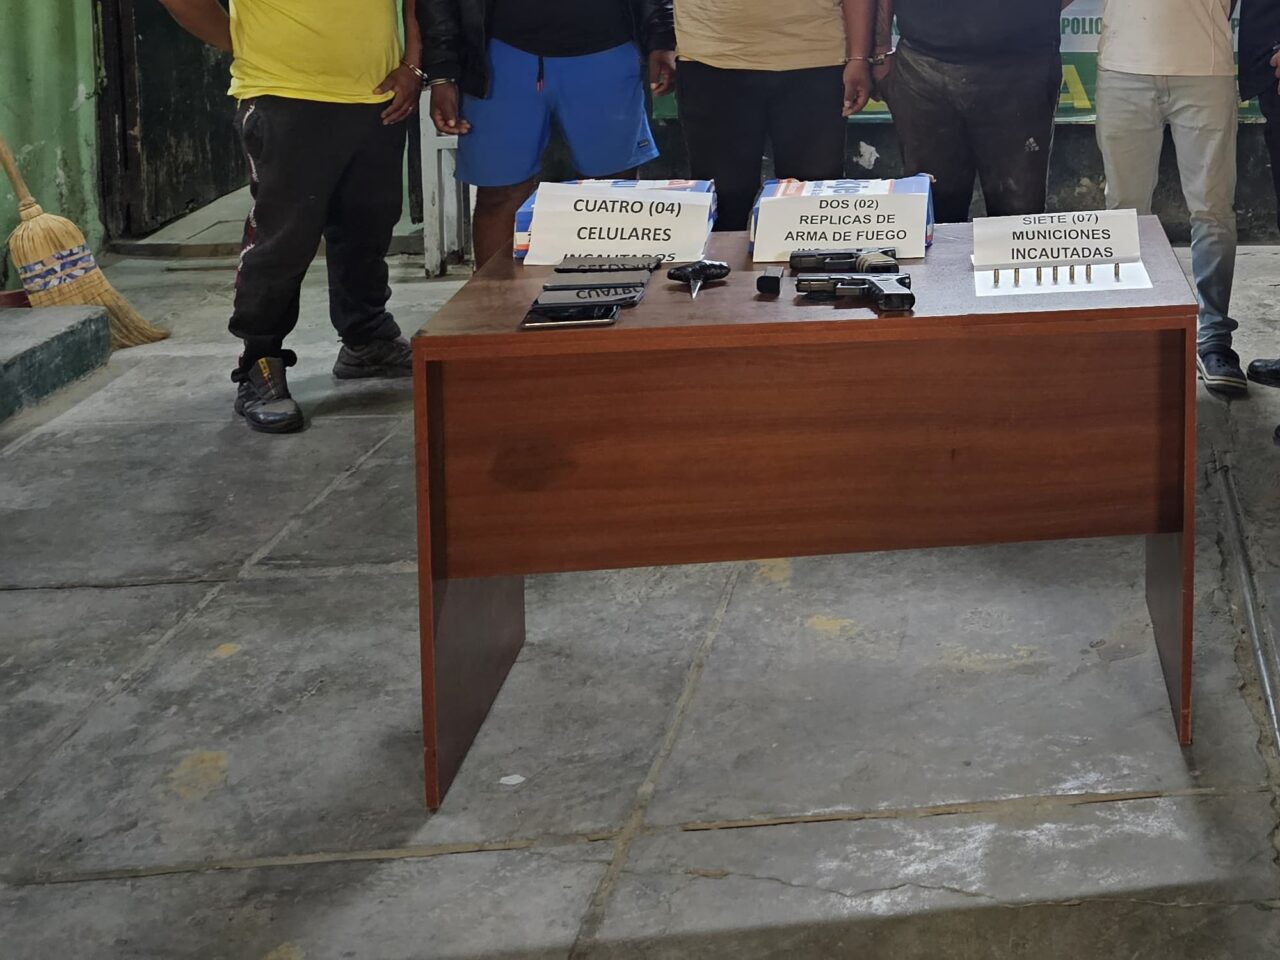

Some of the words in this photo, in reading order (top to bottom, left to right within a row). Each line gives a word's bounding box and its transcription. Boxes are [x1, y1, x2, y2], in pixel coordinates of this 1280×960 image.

[573, 199, 643, 214] CUATRO
[648, 201, 682, 217] (04)
[818, 199, 850, 209] DOS
[853, 199, 879, 211] (02)
[799, 214, 872, 225] REPLICAS
[876, 214, 896, 224] DE
[1022, 215, 1067, 225] SIETE
[1071, 213, 1099, 225] (07)
[576, 226, 672, 242] CELULARES
[784, 231, 829, 241] ARMA
[832, 231, 852, 242] DE
[856, 229, 907, 241] FUEGO
[1012, 228, 1111, 241] MUNICIONES
[1011, 246, 1114, 260] INCAUTADAS
